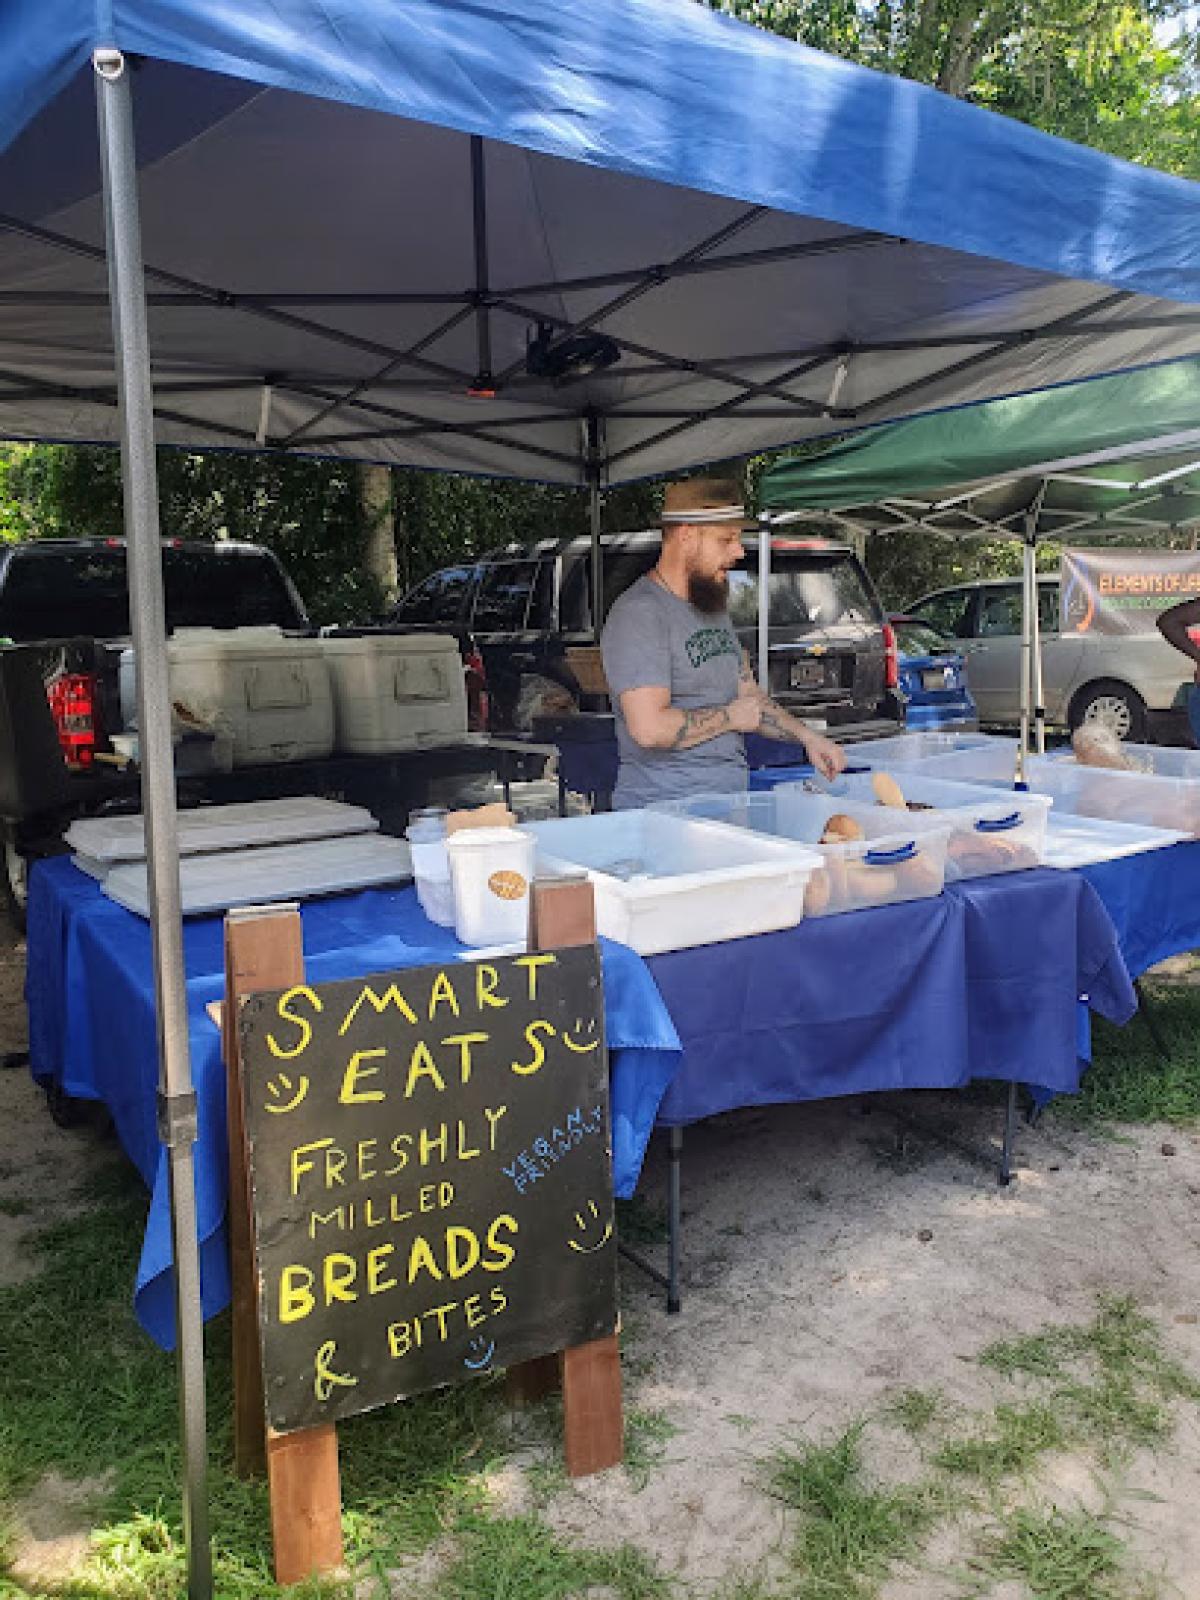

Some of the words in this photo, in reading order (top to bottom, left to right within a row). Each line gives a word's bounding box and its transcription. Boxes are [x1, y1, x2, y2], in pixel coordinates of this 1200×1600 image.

[1100, 573, 1163, 592] ELEMENTS
[266, 954, 556, 1058] SMART
[338, 1020, 556, 1104] EATS
[291, 1105, 507, 1195] FRESHLY
[308, 1181, 455, 1239] MILLED
[279, 1214, 519, 1324] BREADS
[314, 1340, 359, 1401] &
[387, 1284, 507, 1359] BITES
